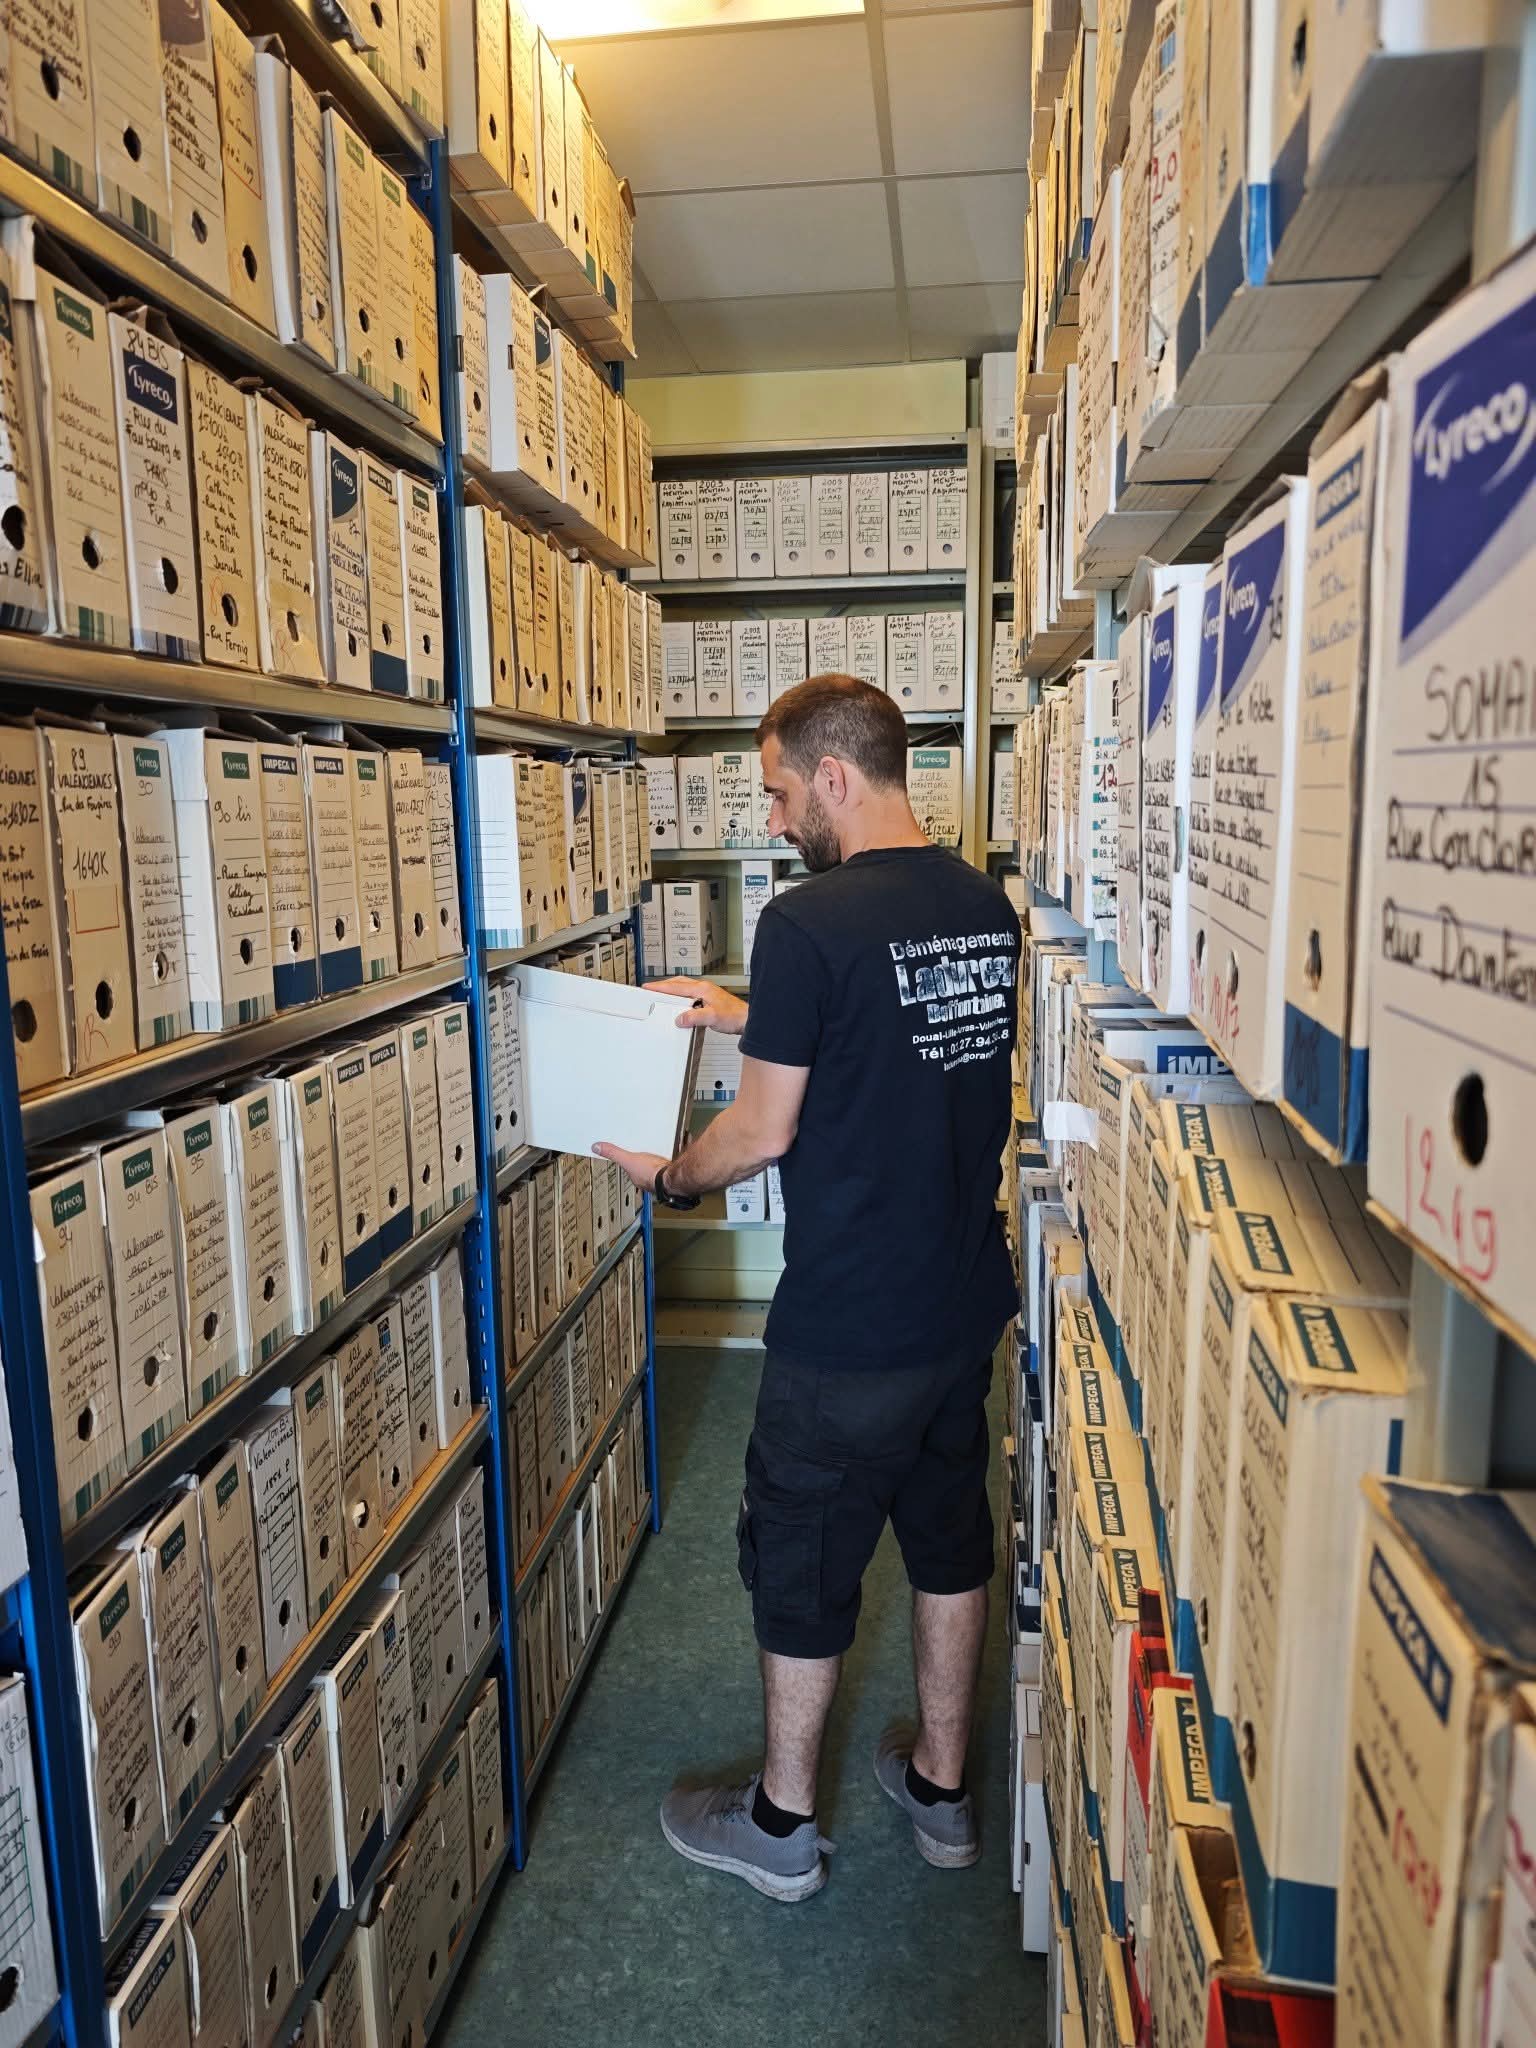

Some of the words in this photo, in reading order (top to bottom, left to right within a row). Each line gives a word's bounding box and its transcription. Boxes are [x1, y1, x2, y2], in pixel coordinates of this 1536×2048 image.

[133, 369, 170, 404] Lyreco
[1425, 381, 1527, 481] Lyreco
[334, 465, 353, 488] Lyreco
[1228, 580, 1256, 620] Lyreco
[1152, 637, 1171, 665] Lyreco
[71, 747, 88, 772] 89
[139, 755, 158, 769] Lyreco
[228, 761, 247, 771] Lyreco
[263, 757, 290, 772] IMPEGA
[315, 759, 338, 772] IMPEGA
[717, 765, 740, 774] 2013
[919, 753, 946, 765] Lyreco
[72, 846, 109, 881] 1640K
[889, 930, 1016, 961] Déménagements
[919, 1047, 944, 1061] Tél
[189, 1130, 208, 1147] Lyreco
[128, 1161, 150, 1178] Lyreco
[57, 1193, 81, 1215] Lyreco
[1087, 1378, 1103, 1425] IMPEGA
[1092, 1442, 1110, 1479] IMPEGA
[1100, 1491, 1121, 1535] IMPEGA
